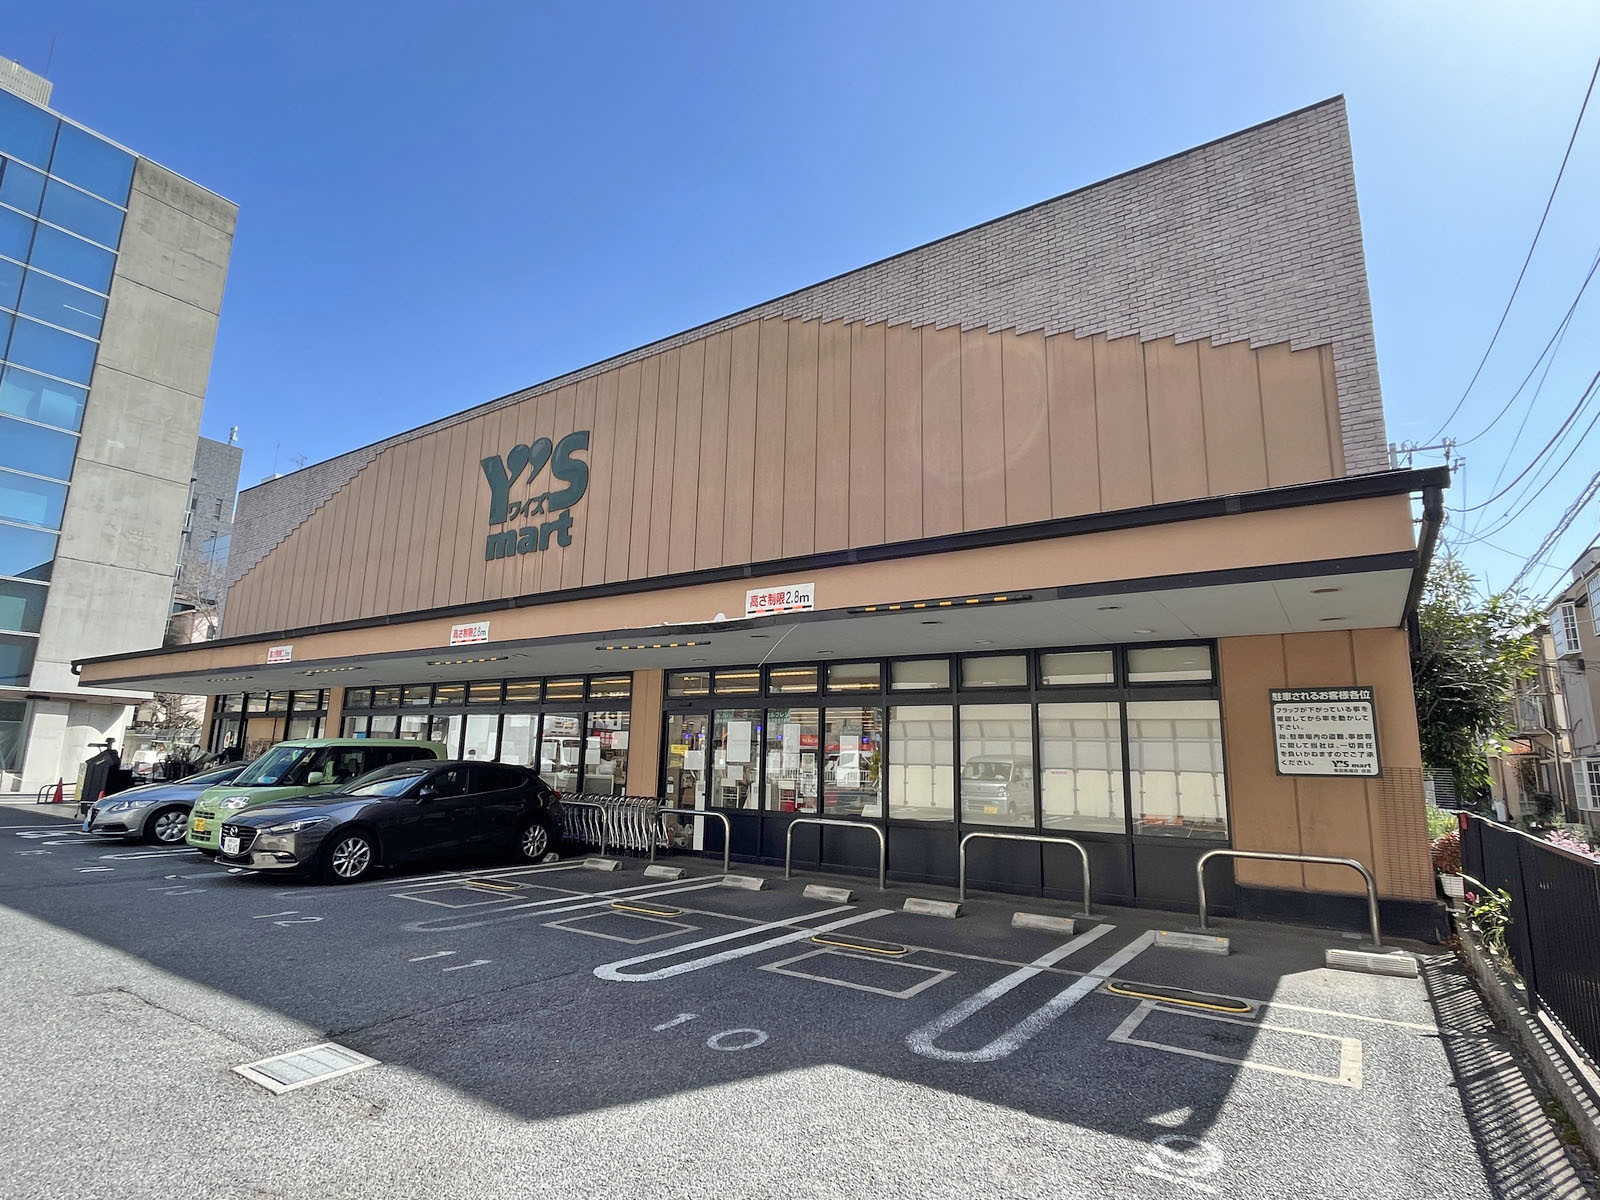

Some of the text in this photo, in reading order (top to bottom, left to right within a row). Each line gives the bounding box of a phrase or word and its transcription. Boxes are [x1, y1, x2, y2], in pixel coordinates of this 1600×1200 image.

[509, 492, 550, 521] ワイズ
[485, 509, 573, 561] mart
[750, 590, 809, 608] 高さ制限2.8m
[1272, 690, 1371, 701] 駐車されるお客様各位
[253, 911, 324, 927] 12
[652, 1013, 770, 1052] 10
